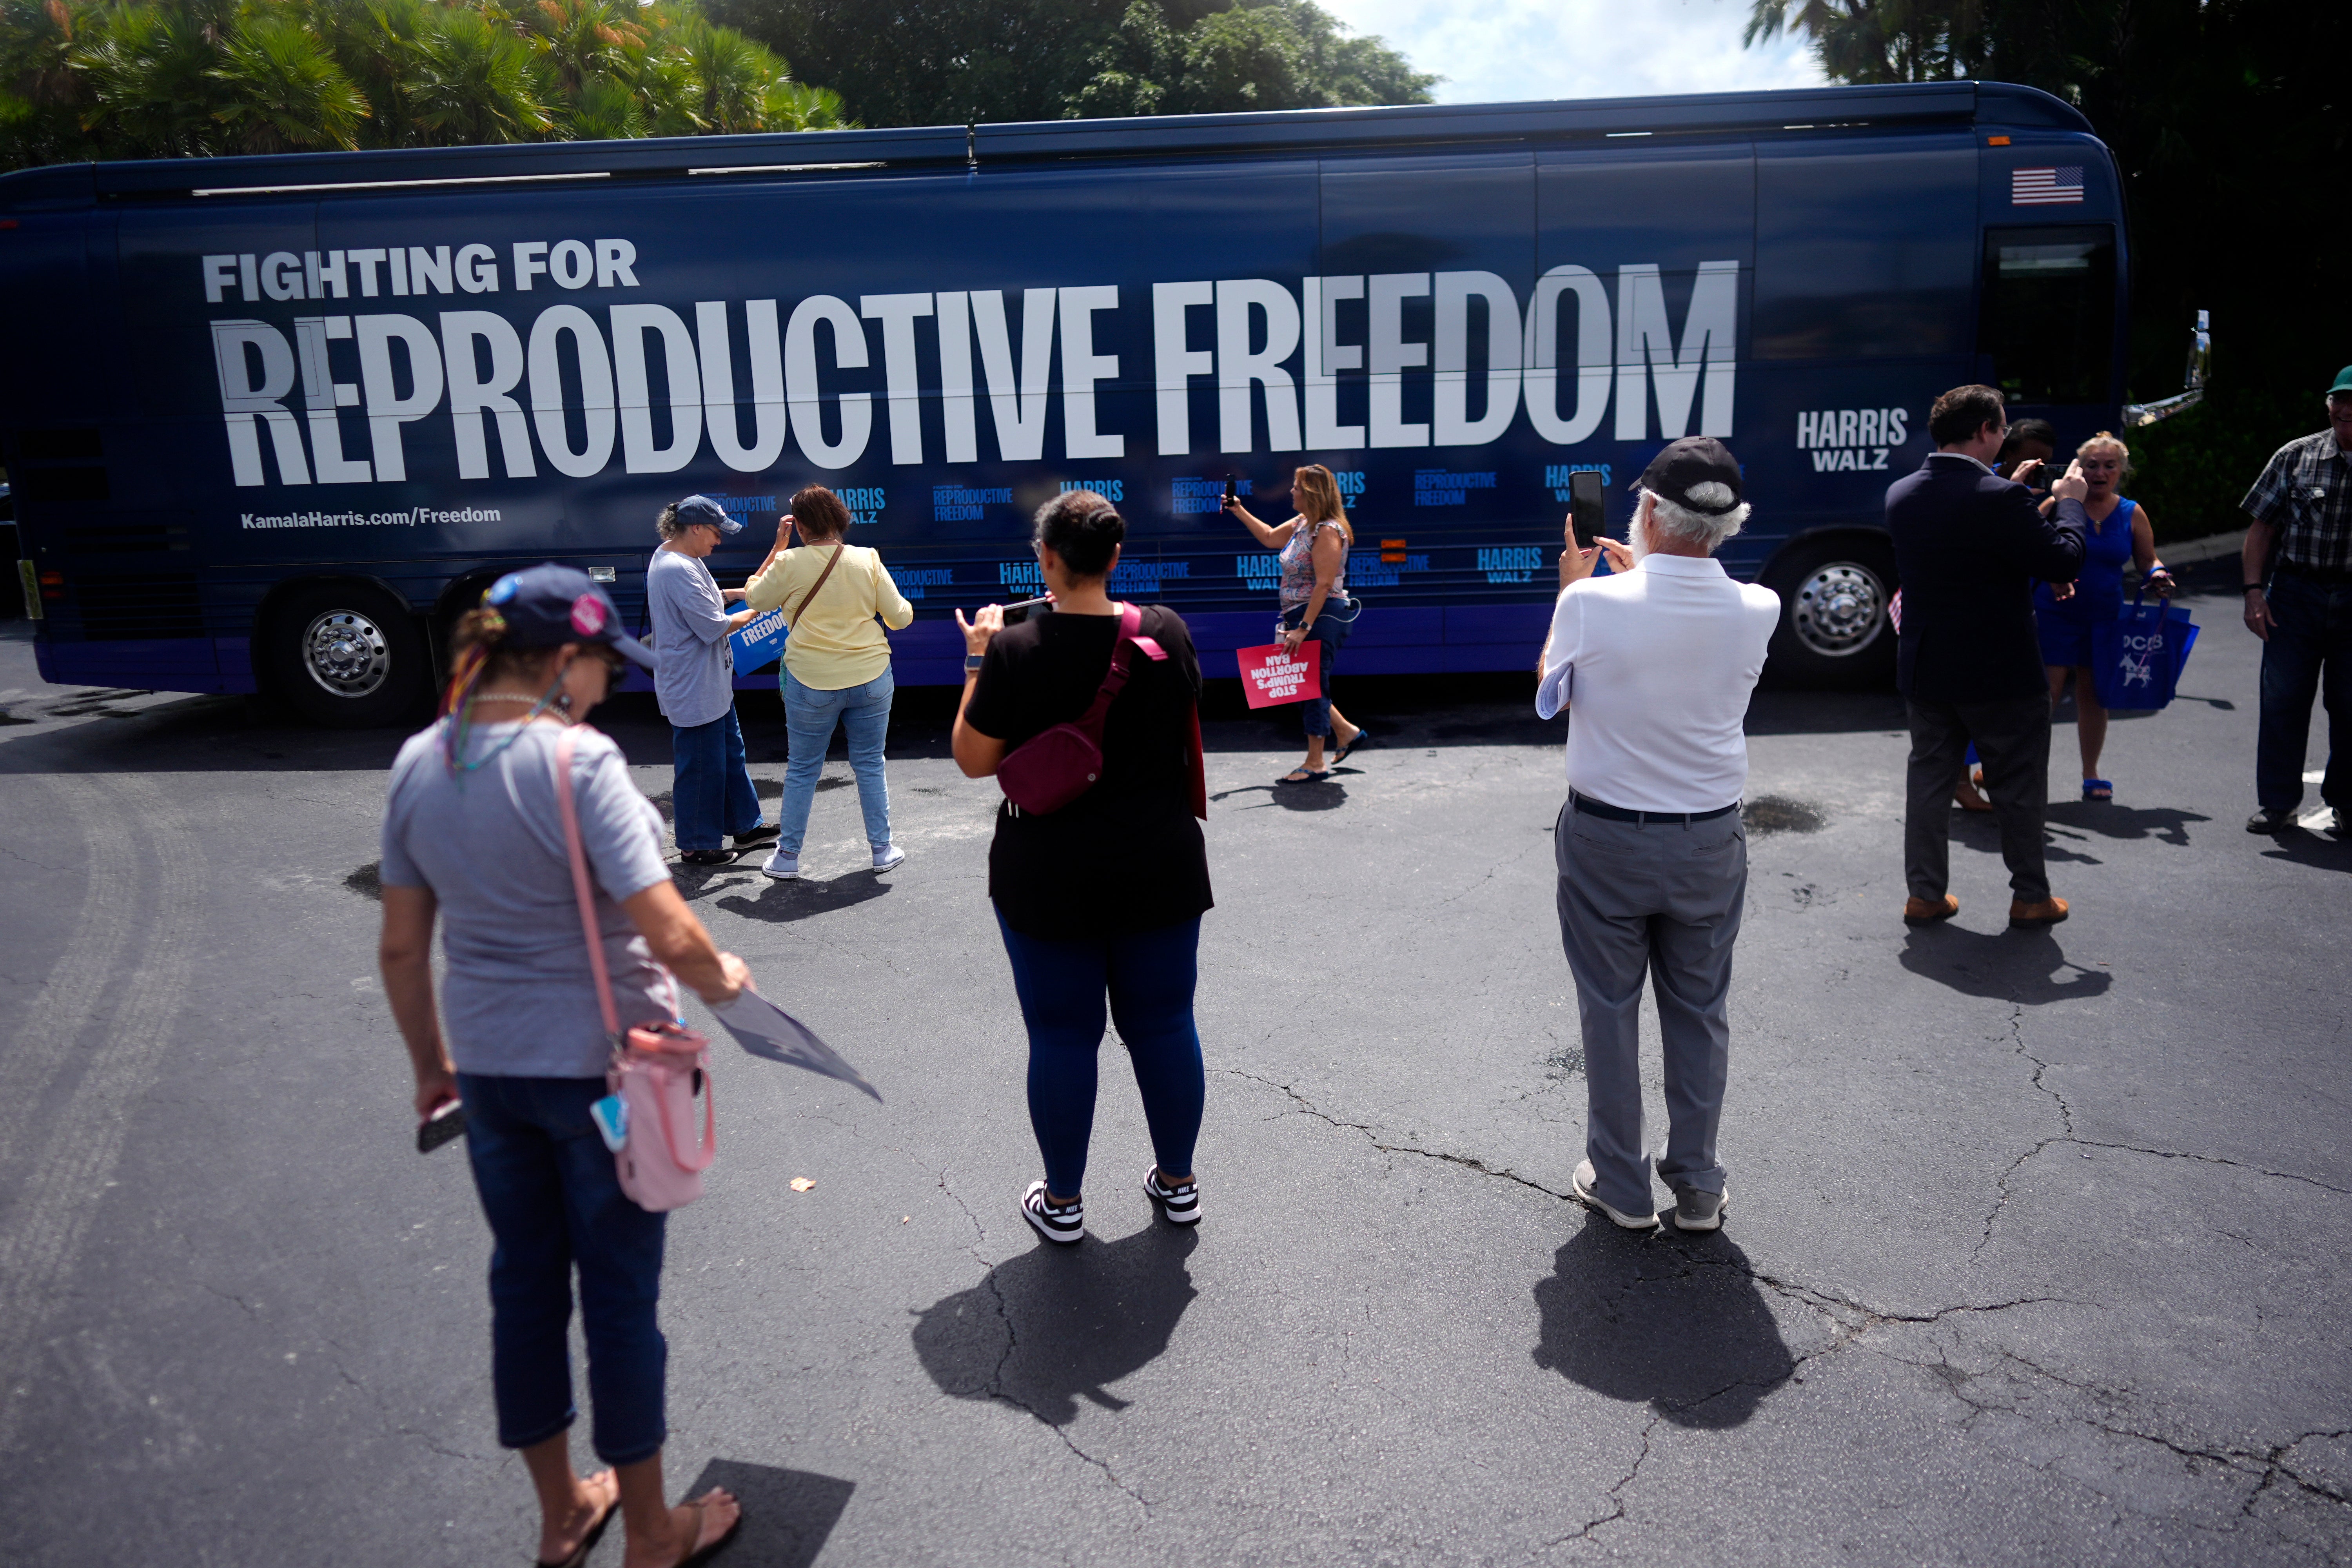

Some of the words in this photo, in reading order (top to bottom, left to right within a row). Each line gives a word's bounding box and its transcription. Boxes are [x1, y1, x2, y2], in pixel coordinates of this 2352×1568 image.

[202, 243, 499, 303] FIGHTING
[512, 238, 640, 291] FOR
[210, 284, 1125, 486] REPRODUCTIVE
[1152, 260, 1739, 455] FREEDOM
[1797, 407, 1908, 449] HARRIS
[1812, 448, 1890, 472] WALZ
[1415, 472, 1497, 490] REPRODUCTIVE
[933, 488, 1013, 505] REPRODUCTIVE
[1415, 490, 1465, 506] FREEDOM
[241, 506, 501, 530] KamalaHarris.com/Freedom
[849, 511, 877, 524] ALZ
[935, 505, 984, 521] FREEDOM
[1477, 547, 1542, 571] HARRIS
[1246, 578, 1280, 590] WAL
[1487, 571, 1532, 583] WALZ
[1266, 653, 1290, 667] BAN
[1251, 662, 1309, 680] ABORTION
[1256, 673, 1306, 690] TRUMP'S
[1269, 685, 1298, 699] STOP
[1178, 1186, 1190, 1194] NIKE
[1065, 1205, 1078, 1214] NIKE
